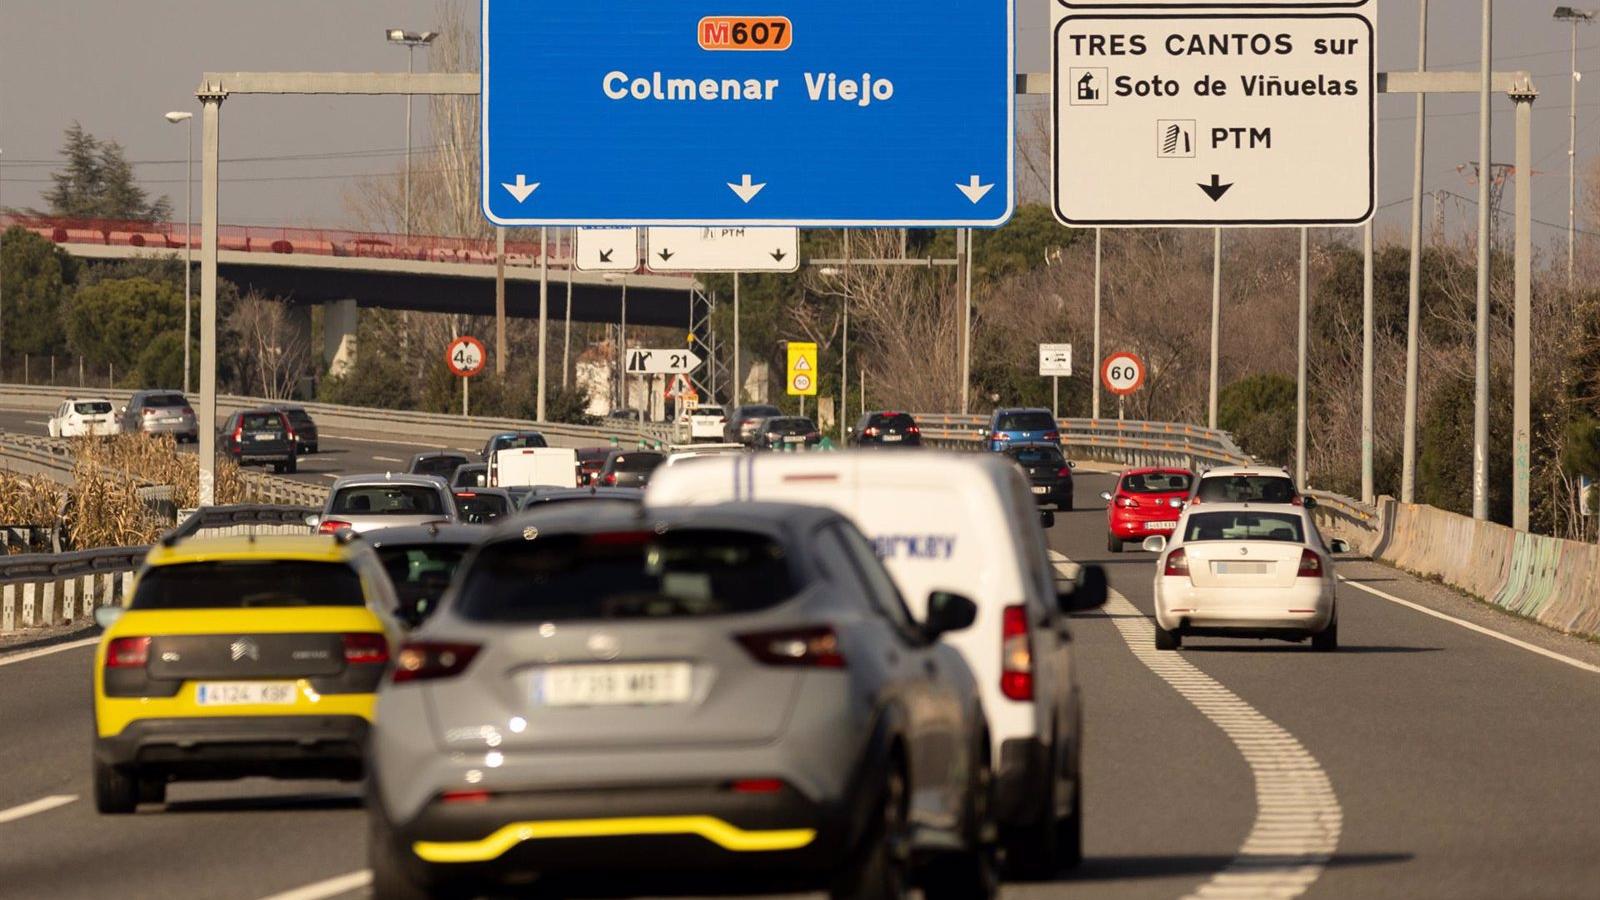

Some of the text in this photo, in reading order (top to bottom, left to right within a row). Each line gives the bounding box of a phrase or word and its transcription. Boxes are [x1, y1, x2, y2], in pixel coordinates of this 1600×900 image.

[704, 22, 786, 45] M607
[1069, 33, 1359, 56] TRES CANTOS sur
[602, 70, 895, 107] Colmenar Viejo
[1114, 74, 1358, 97] Soto de Viñuelas
[1211, 127, 1271, 149] PTM
[721, 227, 745, 238] PTM
[670, 354, 688, 368] 21
[1111, 366, 1135, 380] 60
